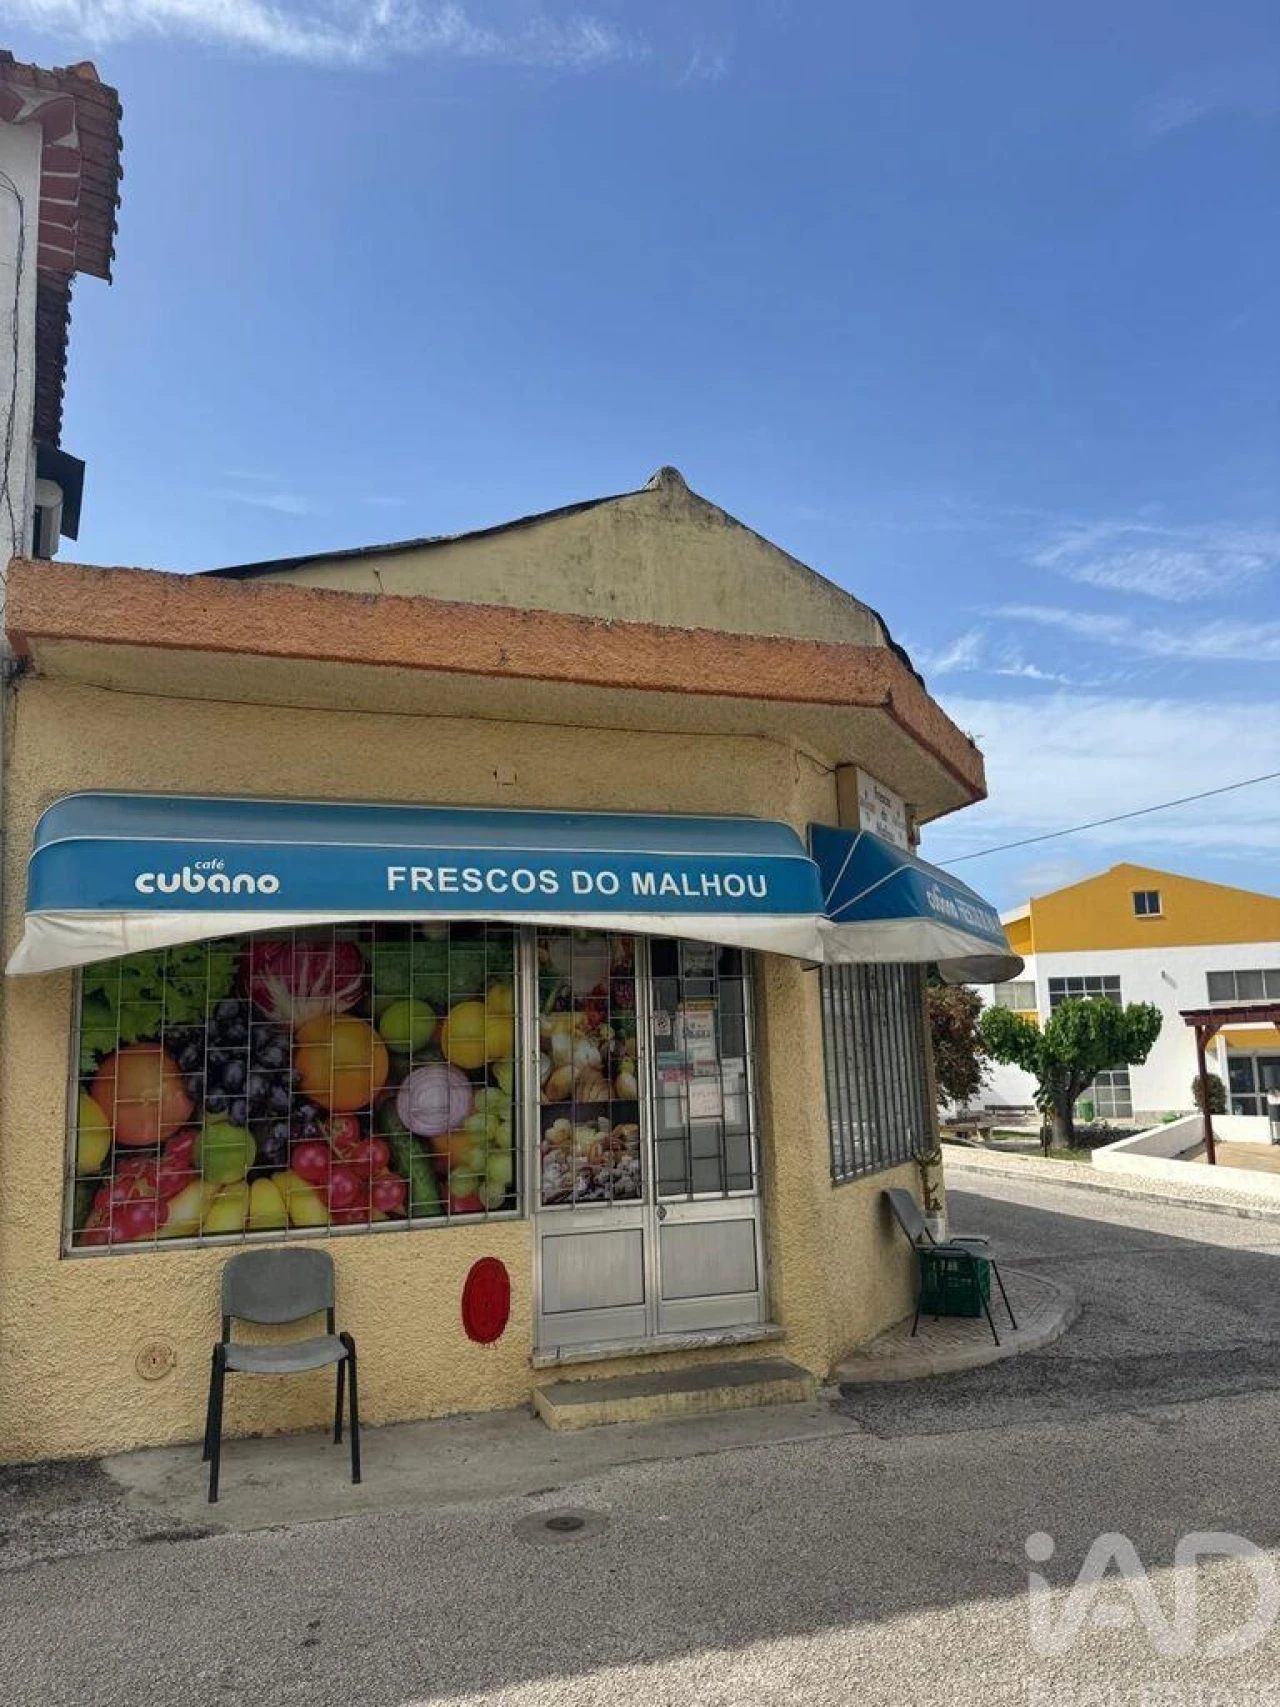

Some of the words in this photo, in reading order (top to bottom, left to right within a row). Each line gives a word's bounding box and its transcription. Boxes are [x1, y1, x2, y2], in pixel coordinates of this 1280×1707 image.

[194, 857, 225, 870] café
[134, 866, 281, 895] cubano
[386, 865, 560, 895] FRESCOS
[571, 870, 620, 896] DO
[631, 871, 768, 898] MALHOU
